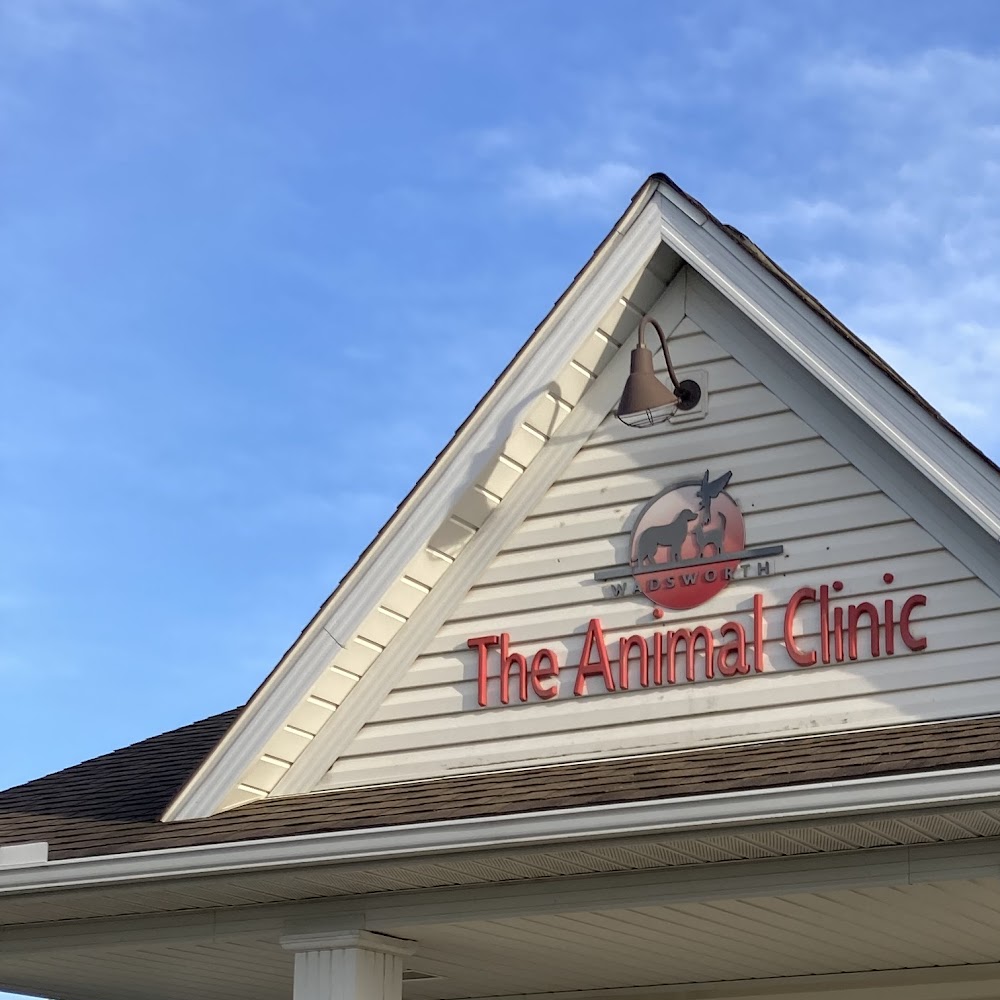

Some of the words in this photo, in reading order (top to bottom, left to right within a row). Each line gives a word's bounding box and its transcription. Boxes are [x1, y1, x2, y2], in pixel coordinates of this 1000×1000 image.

[612, 561, 770, 598] WADSWORTH
[467, 632, 559, 707] The
[573, 593, 765, 697] Animal
[784, 574, 927, 667] Clinic
